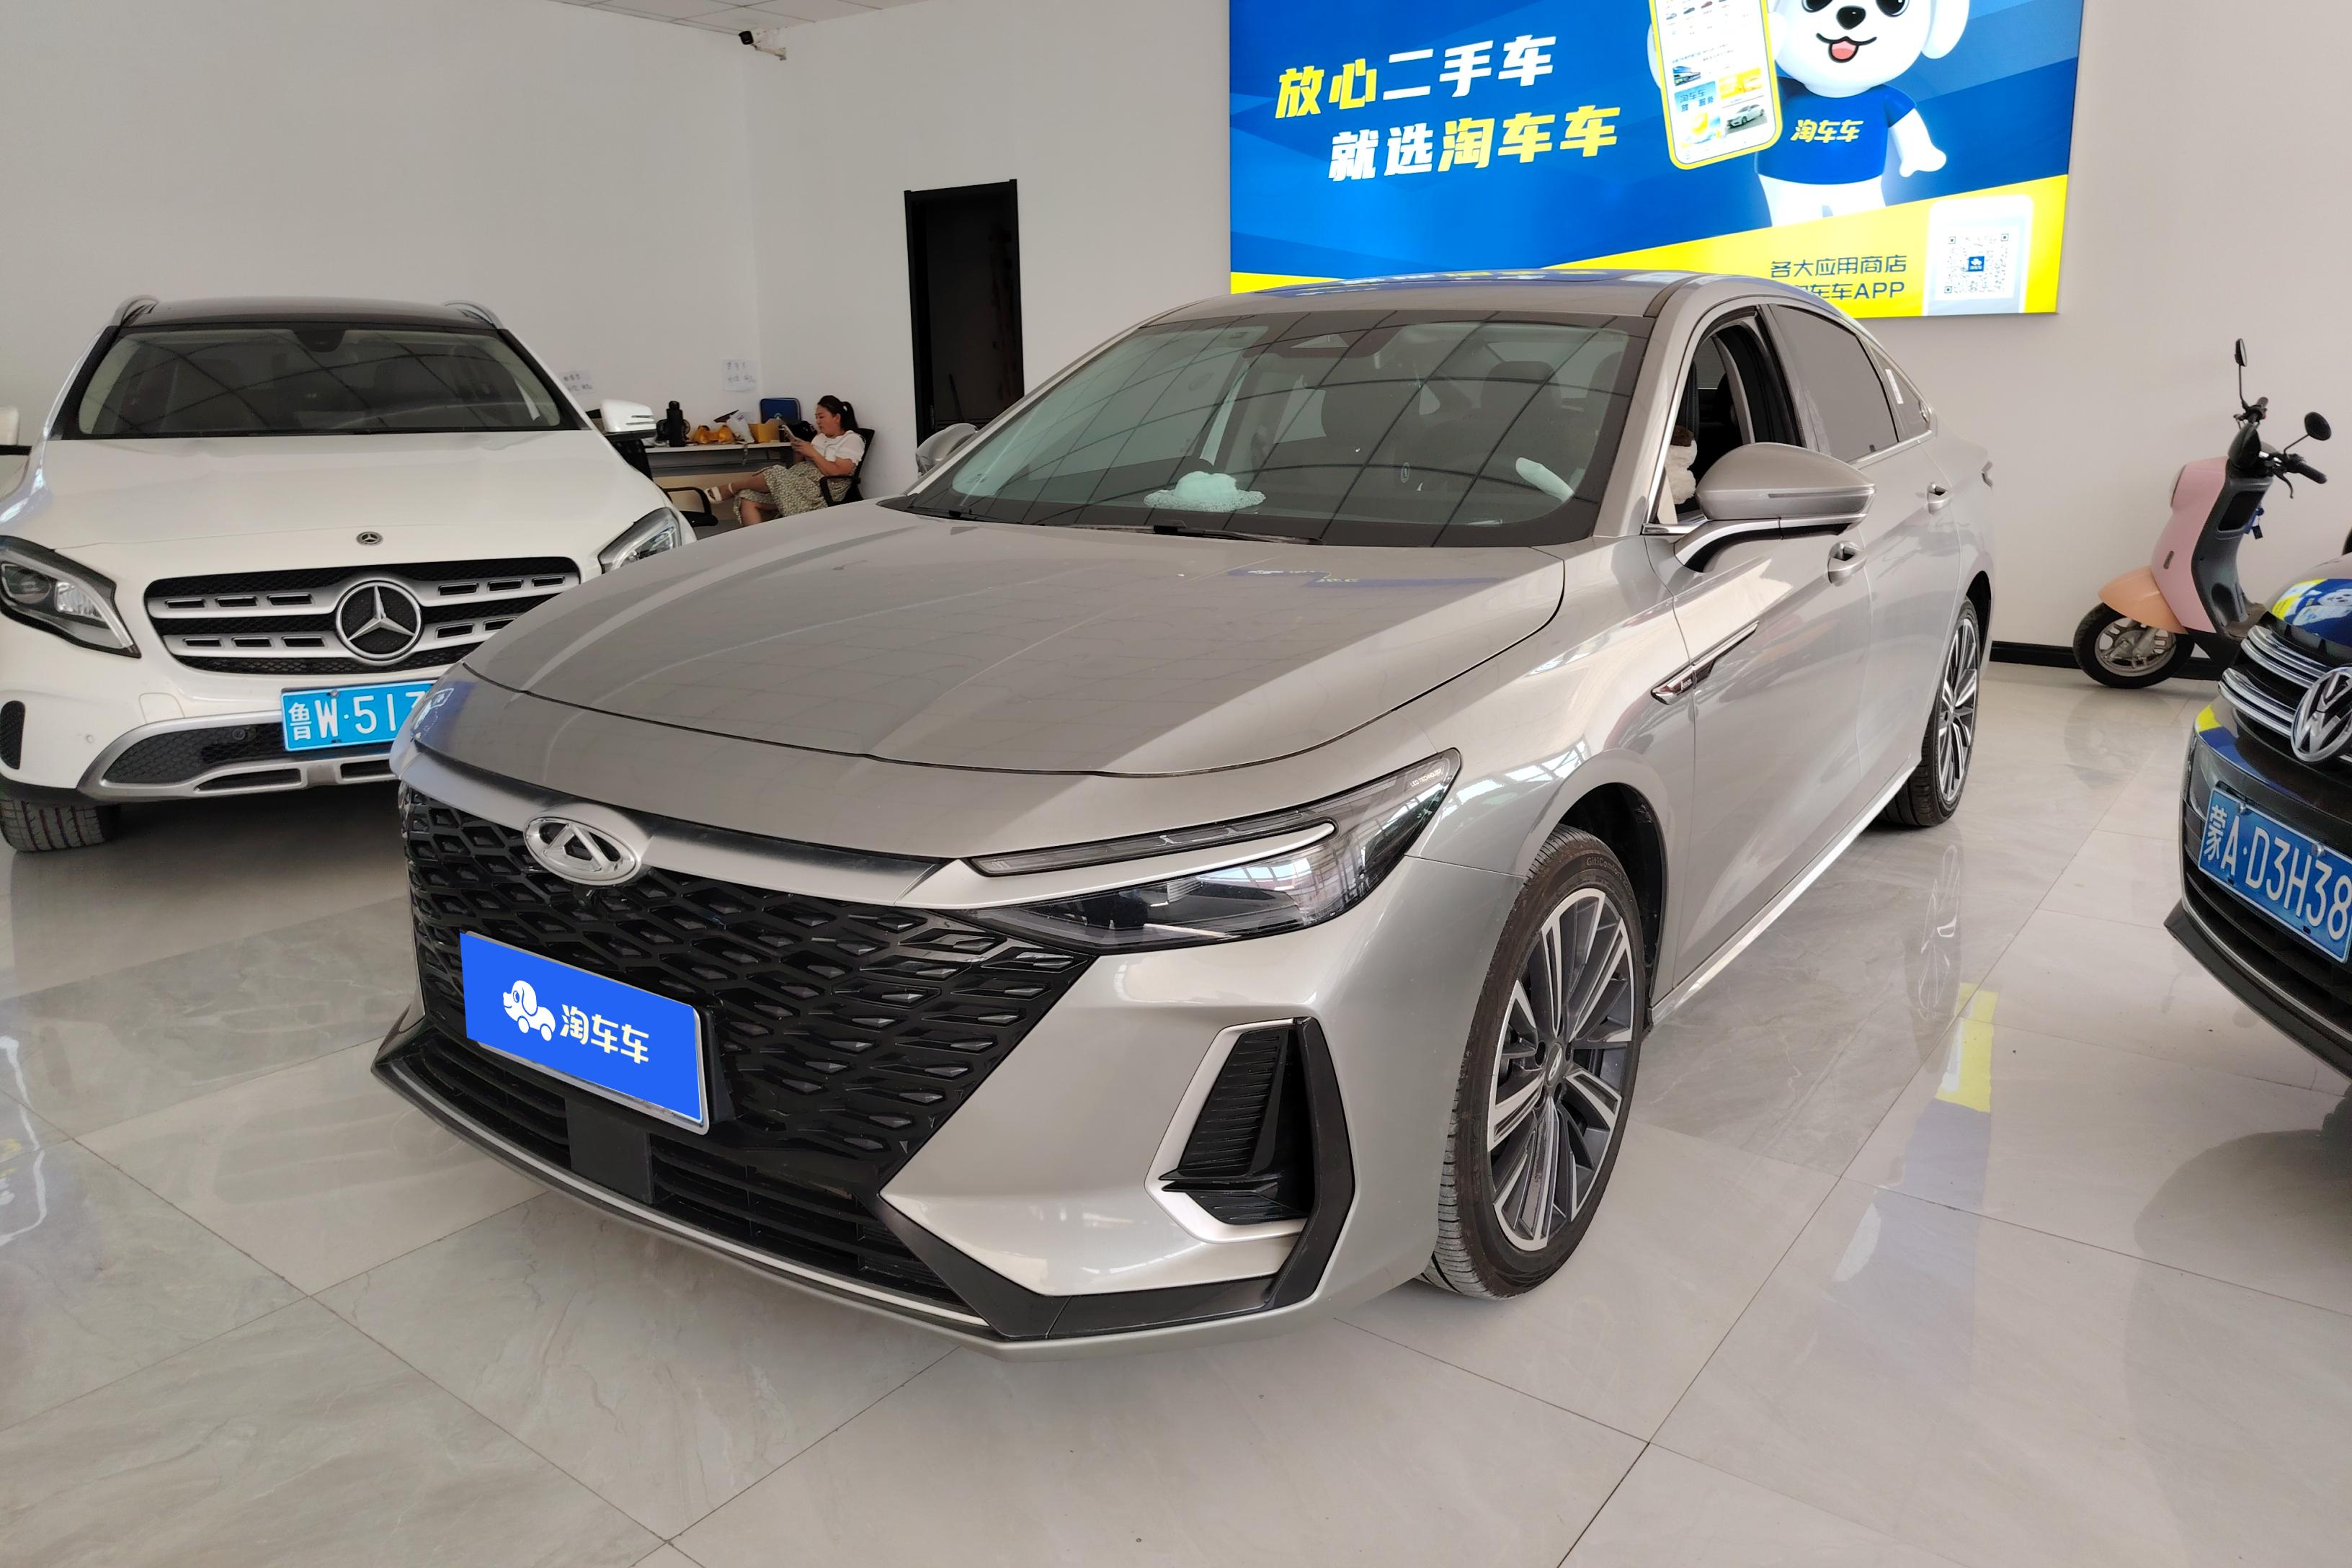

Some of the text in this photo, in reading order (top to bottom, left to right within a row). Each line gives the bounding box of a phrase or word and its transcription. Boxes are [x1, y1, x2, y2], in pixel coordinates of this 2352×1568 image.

[1275, 34, 1556, 119] 放心二手车
[1328, 104, 1621, 182] 就选淘车车
[1791, 119, 1864, 143] 淘车车
[1770, 254, 1907, 278] 各大应用商店
[1794, 281, 1905, 300] 车车APP
